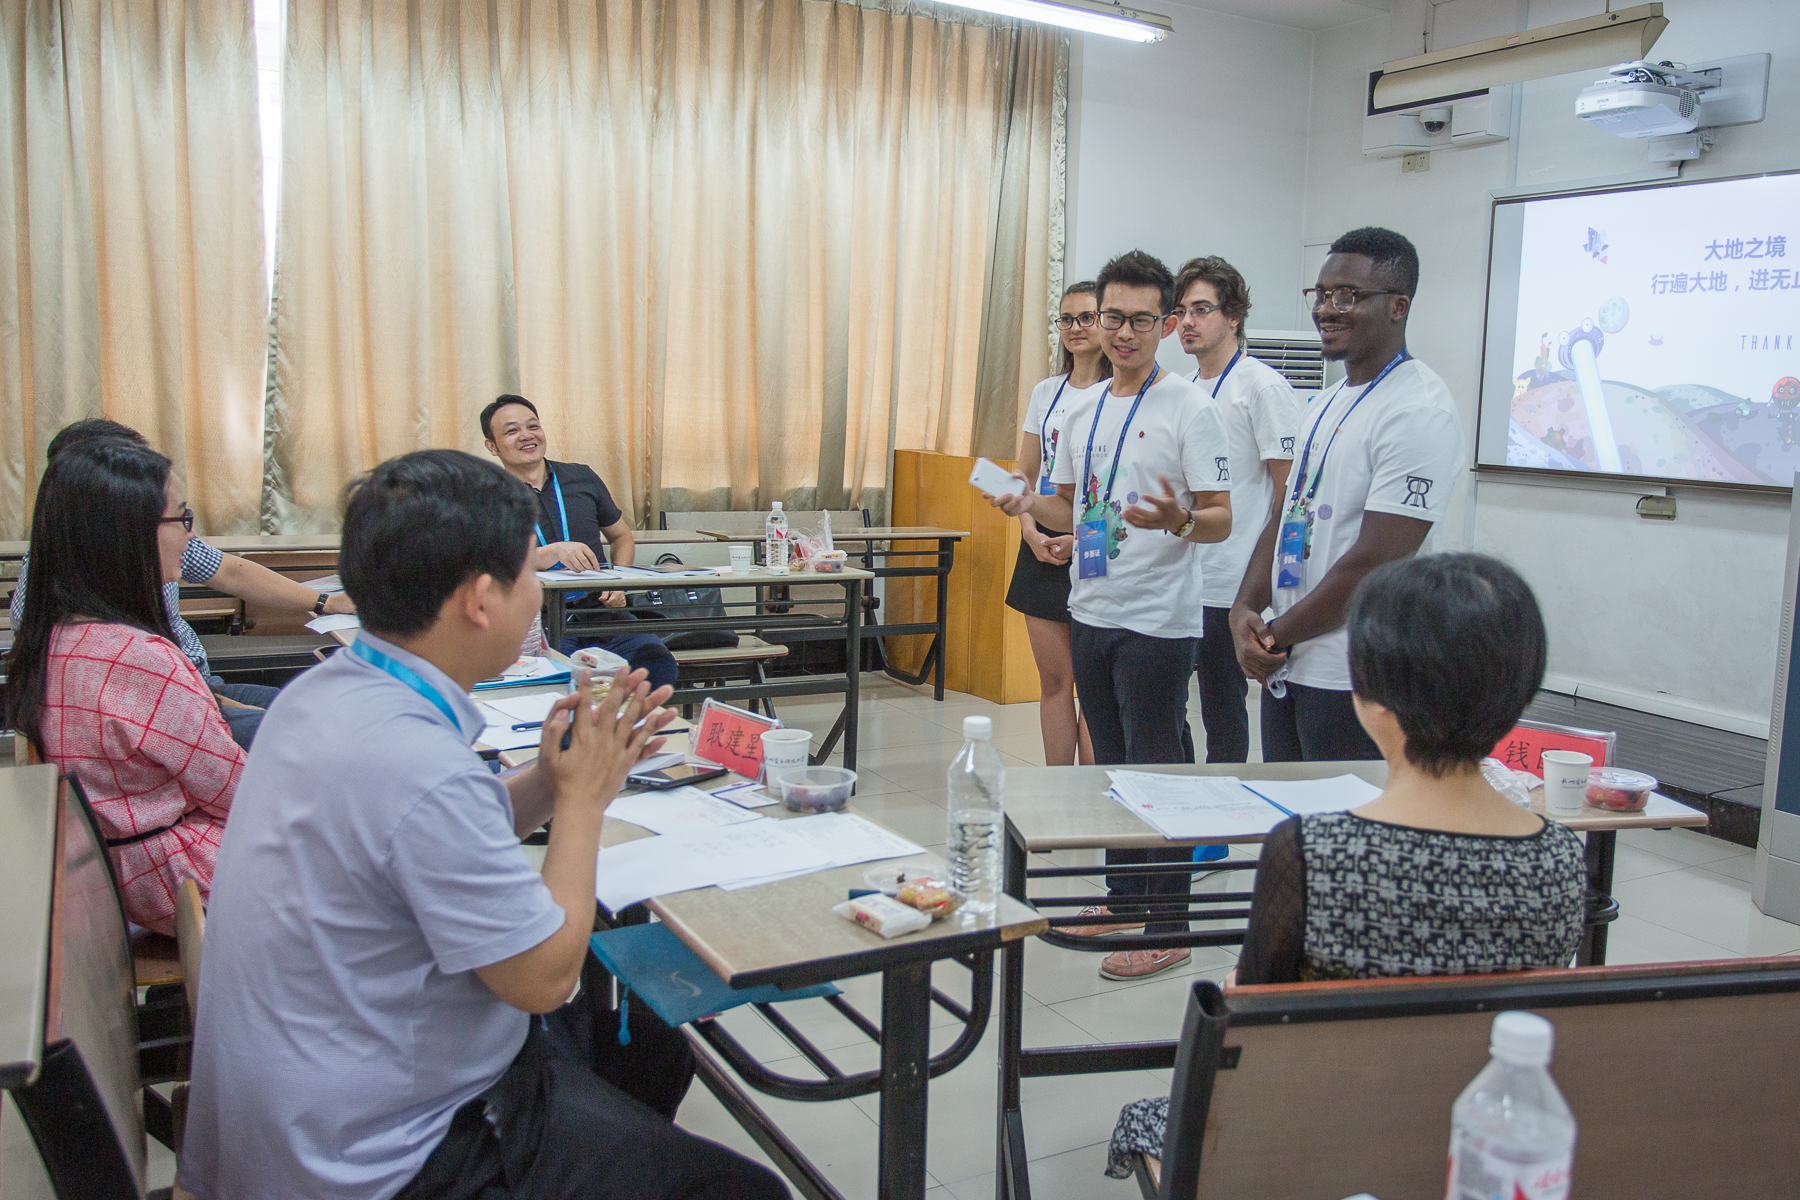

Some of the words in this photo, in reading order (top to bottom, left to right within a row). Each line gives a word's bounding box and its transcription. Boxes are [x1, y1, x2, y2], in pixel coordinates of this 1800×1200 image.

[1703, 235, 1787, 262] 大地之境
[1741, 335, 1793, 350] THANK
[706, 722, 761, 761] 耿建星
